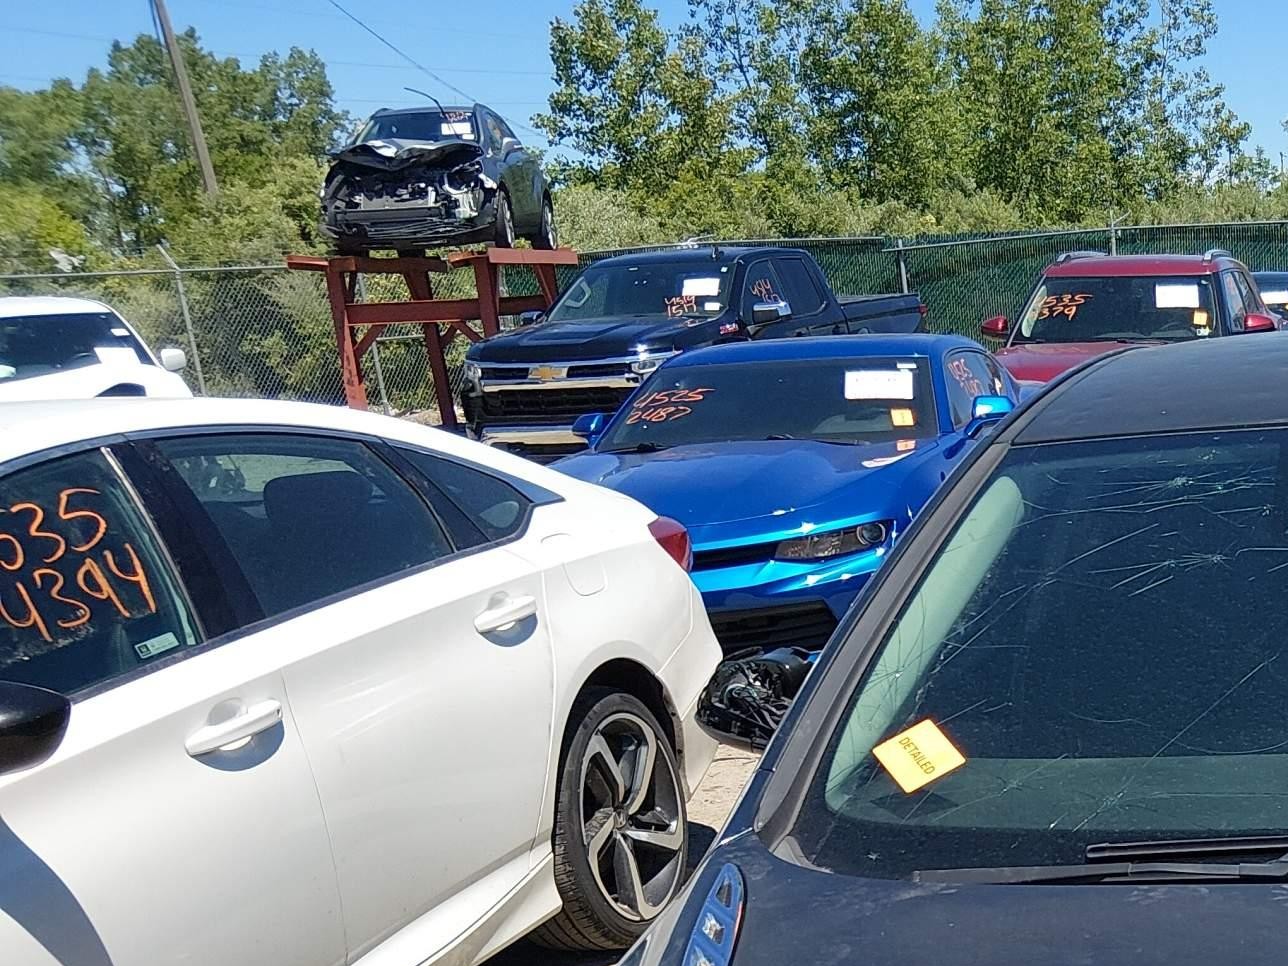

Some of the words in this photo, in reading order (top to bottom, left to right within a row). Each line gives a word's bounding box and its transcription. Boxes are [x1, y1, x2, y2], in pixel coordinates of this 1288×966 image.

[633, 388, 717, 409] 4525
[626, 406, 693, 425] 2487
[0, 543, 157, 642] 4394
[898, 736, 936, 775] DETAILED
